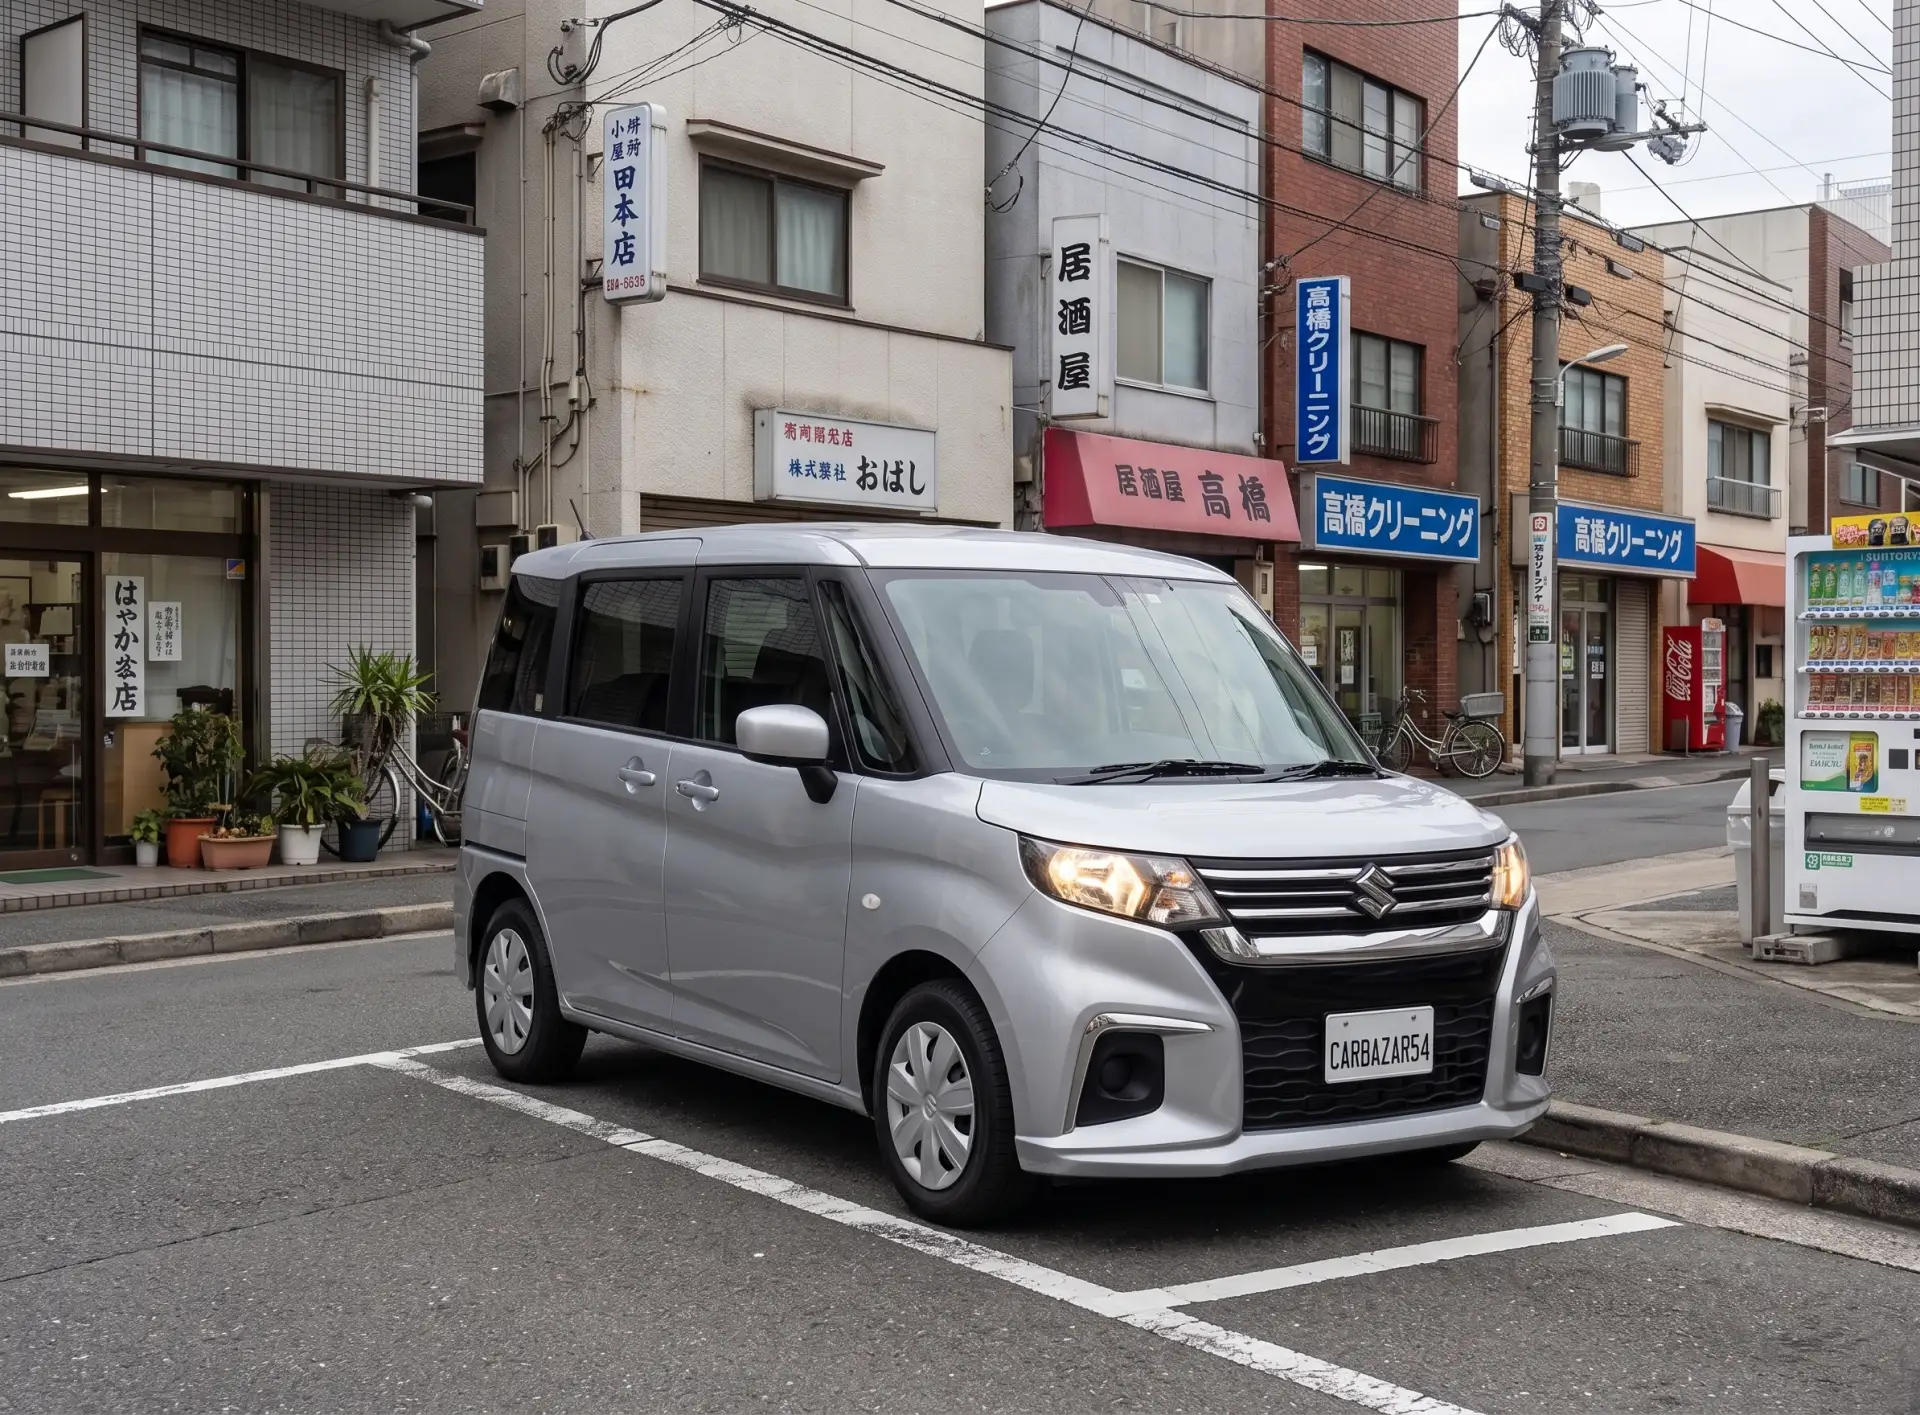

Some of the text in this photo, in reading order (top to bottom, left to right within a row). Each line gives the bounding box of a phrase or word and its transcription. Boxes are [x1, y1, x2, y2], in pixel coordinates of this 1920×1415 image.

[1058, 242, 1092, 391] 居酒屋
[1306, 286, 1332, 455] 高橋クリーニング
[856, 455, 926, 496] おばし
[1114, 464, 1271, 523] 居酒屋 高橋
[1322, 490, 1474, 548] 高橋クリーニング
[1574, 516, 1683, 564] 高橋クリーニング
[1866, 551, 1920, 562] SUNTORY
[1330, 1033, 1430, 1070] CARBAZAR54
